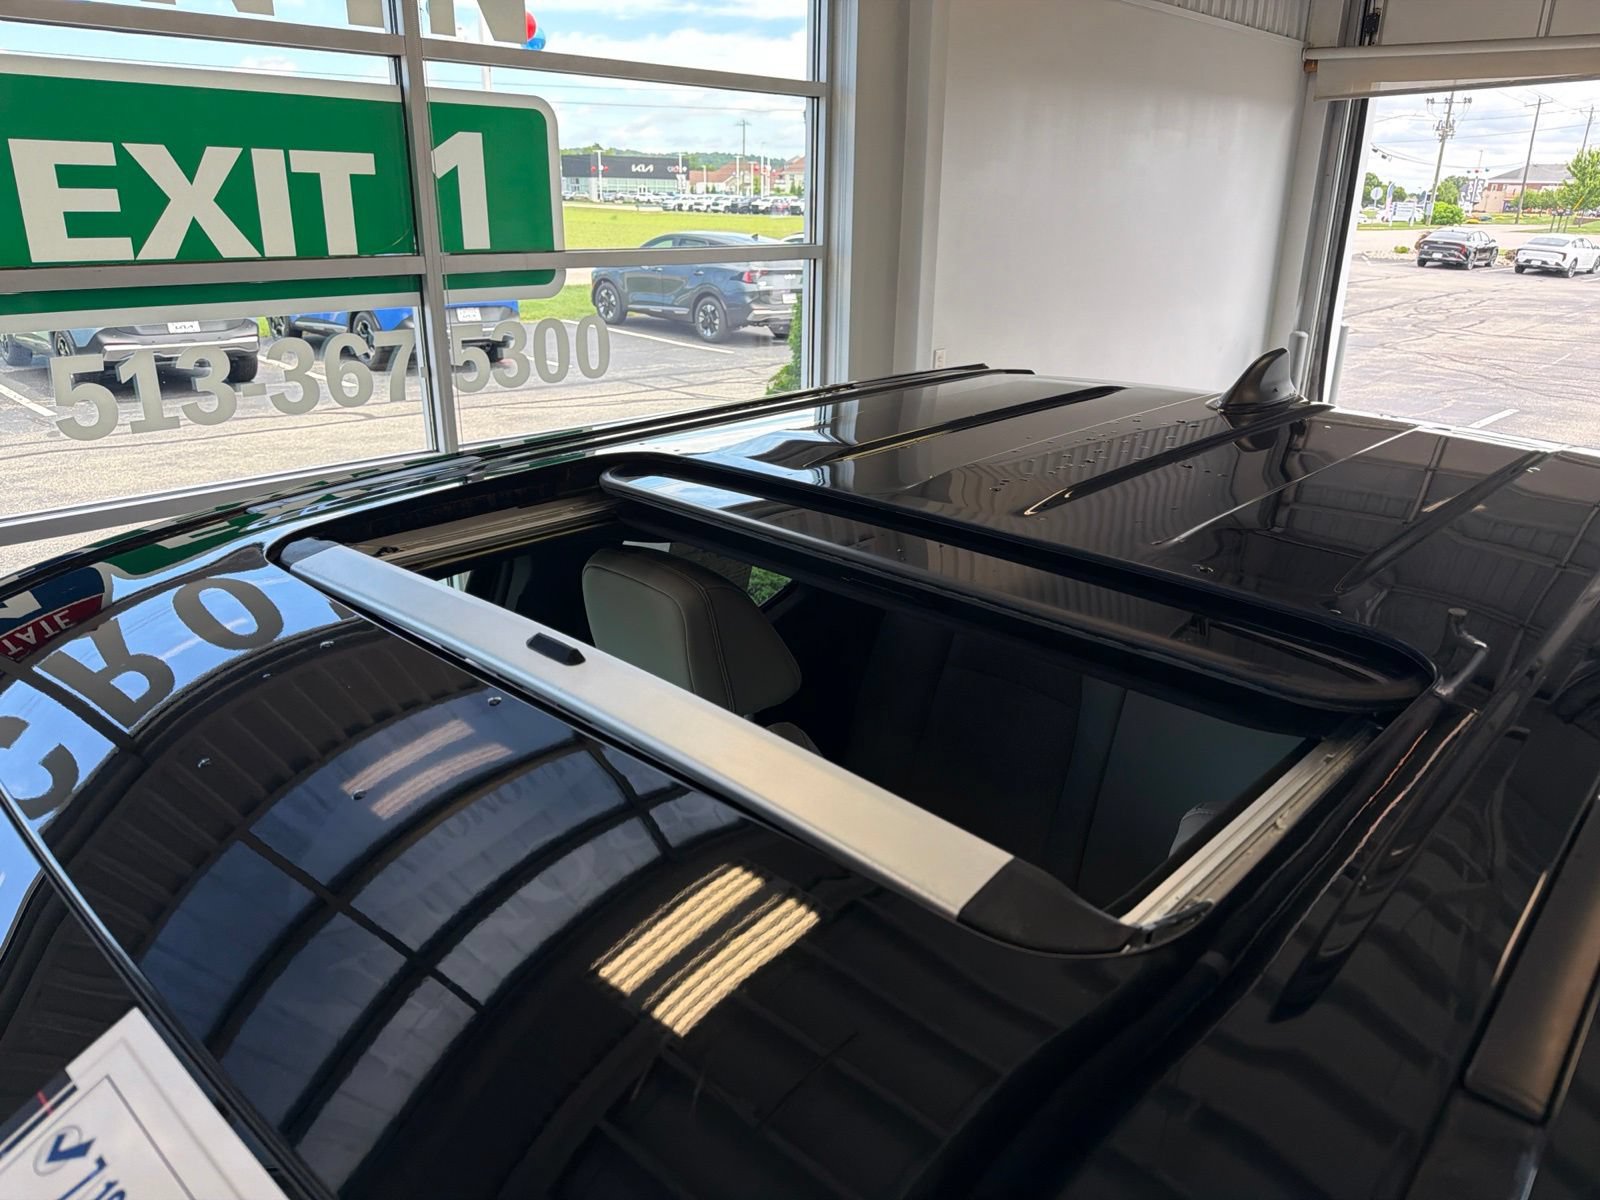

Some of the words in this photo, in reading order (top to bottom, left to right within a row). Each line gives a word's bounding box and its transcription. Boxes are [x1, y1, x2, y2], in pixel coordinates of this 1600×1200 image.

[8, 138, 376, 263] EXIT
[431, 131, 491, 250] 1
[50, 315, 611, 441] 513-3675300
